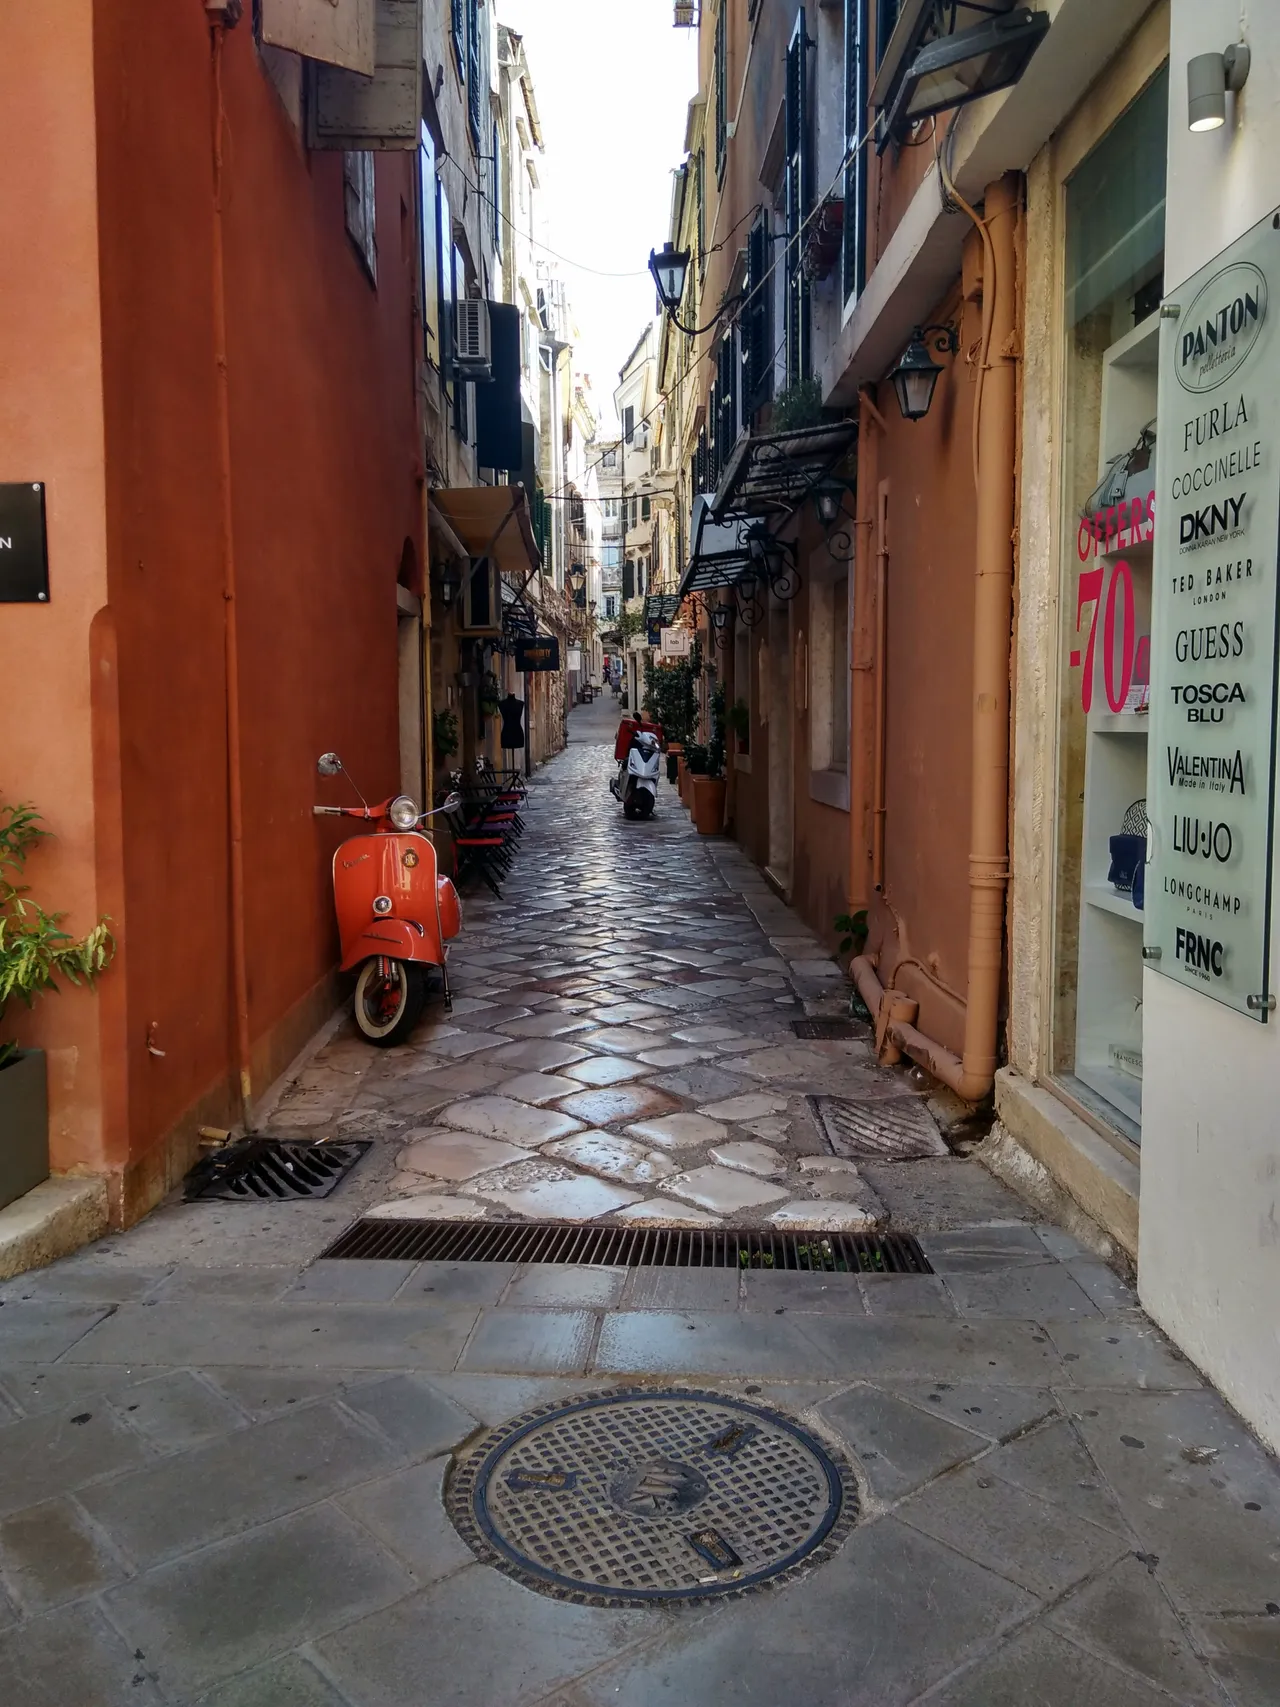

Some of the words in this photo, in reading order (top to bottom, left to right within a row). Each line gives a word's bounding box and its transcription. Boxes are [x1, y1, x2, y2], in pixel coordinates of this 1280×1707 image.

[1182, 285, 1259, 367] PANTON
[1184, 394, 1248, 452] FURLA
[1172, 441, 1261, 500] COCCINELLE
[1077, 490, 1155, 561] OFFERS
[1180, 492, 1247, 545] DKNY
[1179, 544, 1197, 555] DONNA
[1197, 538, 1216, 549] KARAN
[1216, 533, 1229, 544] NEW
[1229, 528, 1245, 539] YORK
[1173, 574, 1194, 594] TED
[1206, 559, 1252, 587] BAKER
[1193, 591, 1227, 605] LONDON
[1175, 621, 1244, 663] GUESS
[1171, 682, 1246, 704] TOSCA
[1187, 708, 1224, 723] BLU
[1179, 777, 1197, 788] Made
[1209, 781, 1225, 793] Italy
[1164, 876, 1240, 914] LONGCHAMP
[1186, 906, 1212, 920] PARIS
[1176, 926, 1223, 977] FRNC
[1184, 965, 1198, 977] SINCE
[1199, 972, 1210, 982] 1960
